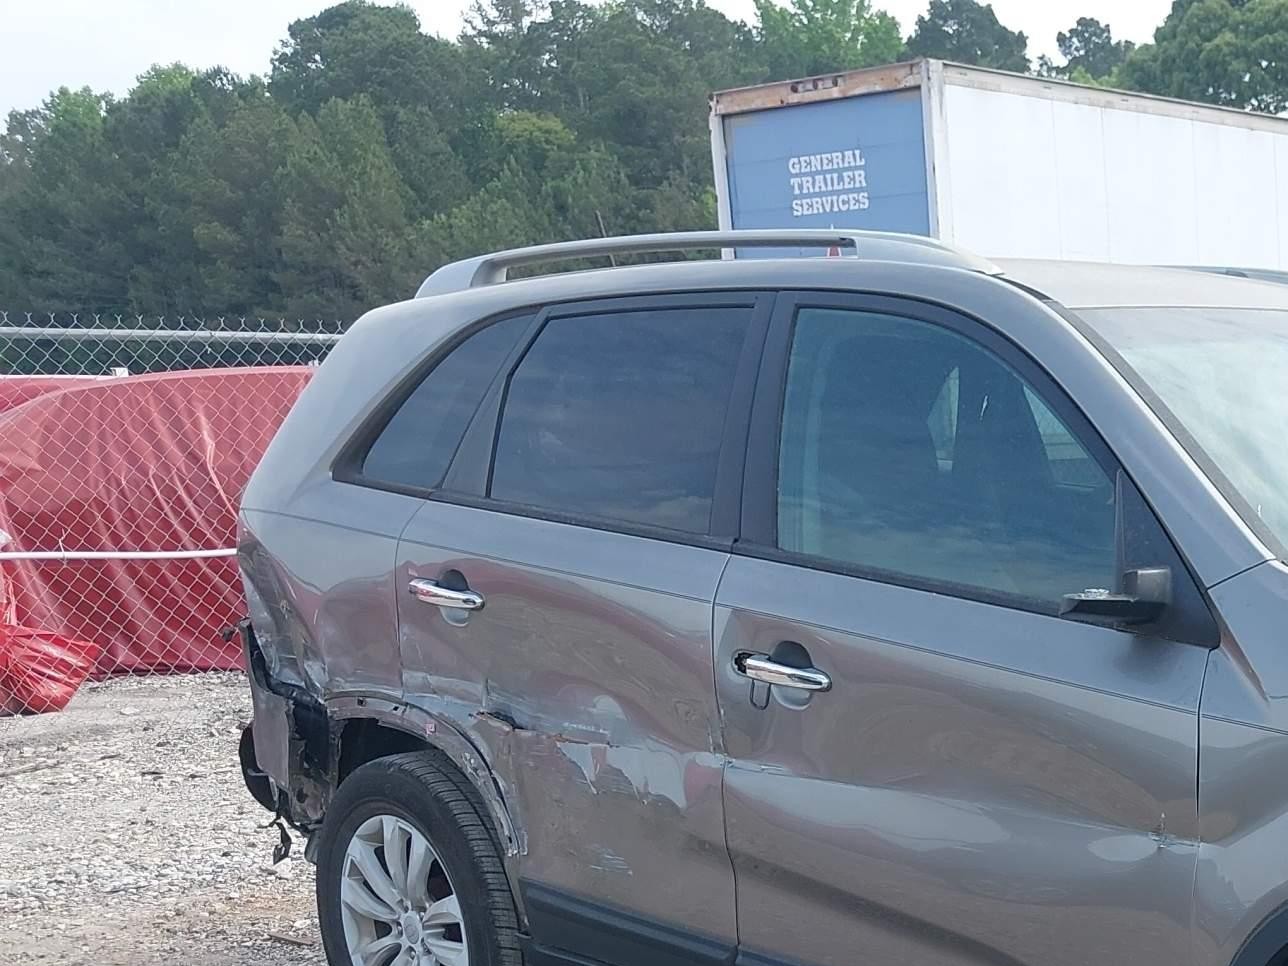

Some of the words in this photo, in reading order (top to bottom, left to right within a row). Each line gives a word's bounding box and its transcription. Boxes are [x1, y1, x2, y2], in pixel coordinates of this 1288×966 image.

[788, 149, 866, 174] GENERAL
[790, 170, 867, 195] TRAILER
[792, 191, 870, 217] SERVICES
